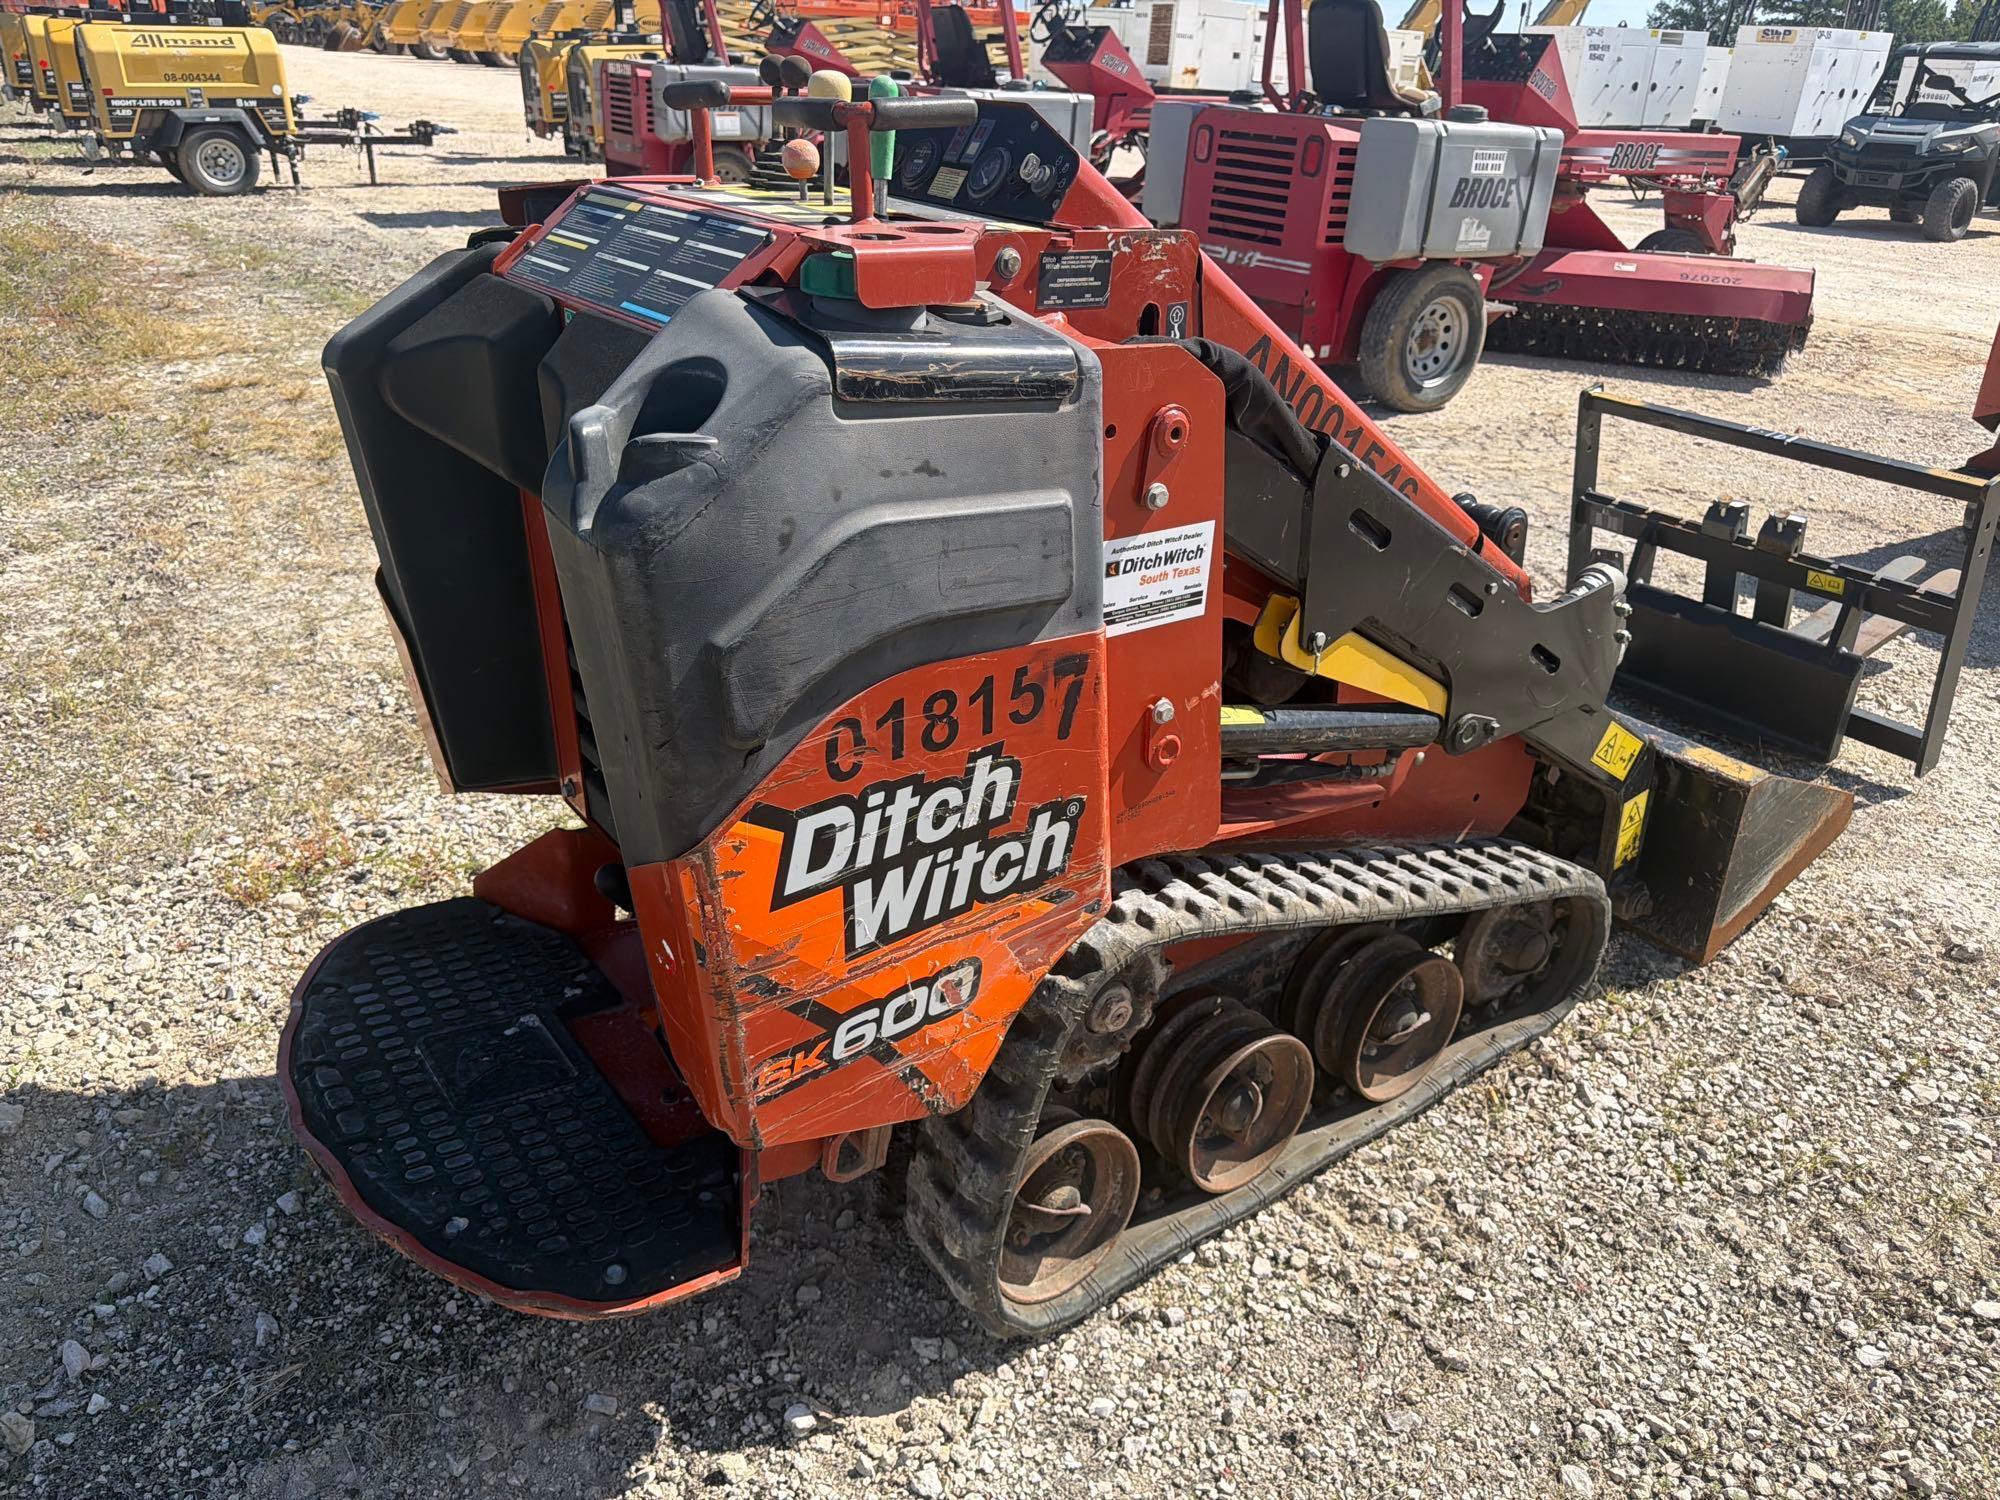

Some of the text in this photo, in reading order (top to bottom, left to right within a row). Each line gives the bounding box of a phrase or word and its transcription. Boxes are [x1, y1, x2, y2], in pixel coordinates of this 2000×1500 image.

[130, 33, 236, 48] Allmand
[163, 72, 222, 83] 08-004344
[111, 98, 158, 107] NIGHT-LITE
[159, 98, 176, 107] PRO
[1608, 142, 1664, 171] BROCE
[1448, 177, 1517, 209] BROCE
[1111, 543, 1146, 555] Authorized
[1147, 538, 1163, 548] Ditch
[1183, 532, 1203, 541] Dealer
[1139, 566, 1201, 586] South Texas
[1129, 595, 1148, 603] Service
[1160, 589, 1173, 597] Parts
[825, 653, 1090, 783] 018157
[783, 753, 1013, 897] Ditch
[853, 812, 1071, 950] Witch
